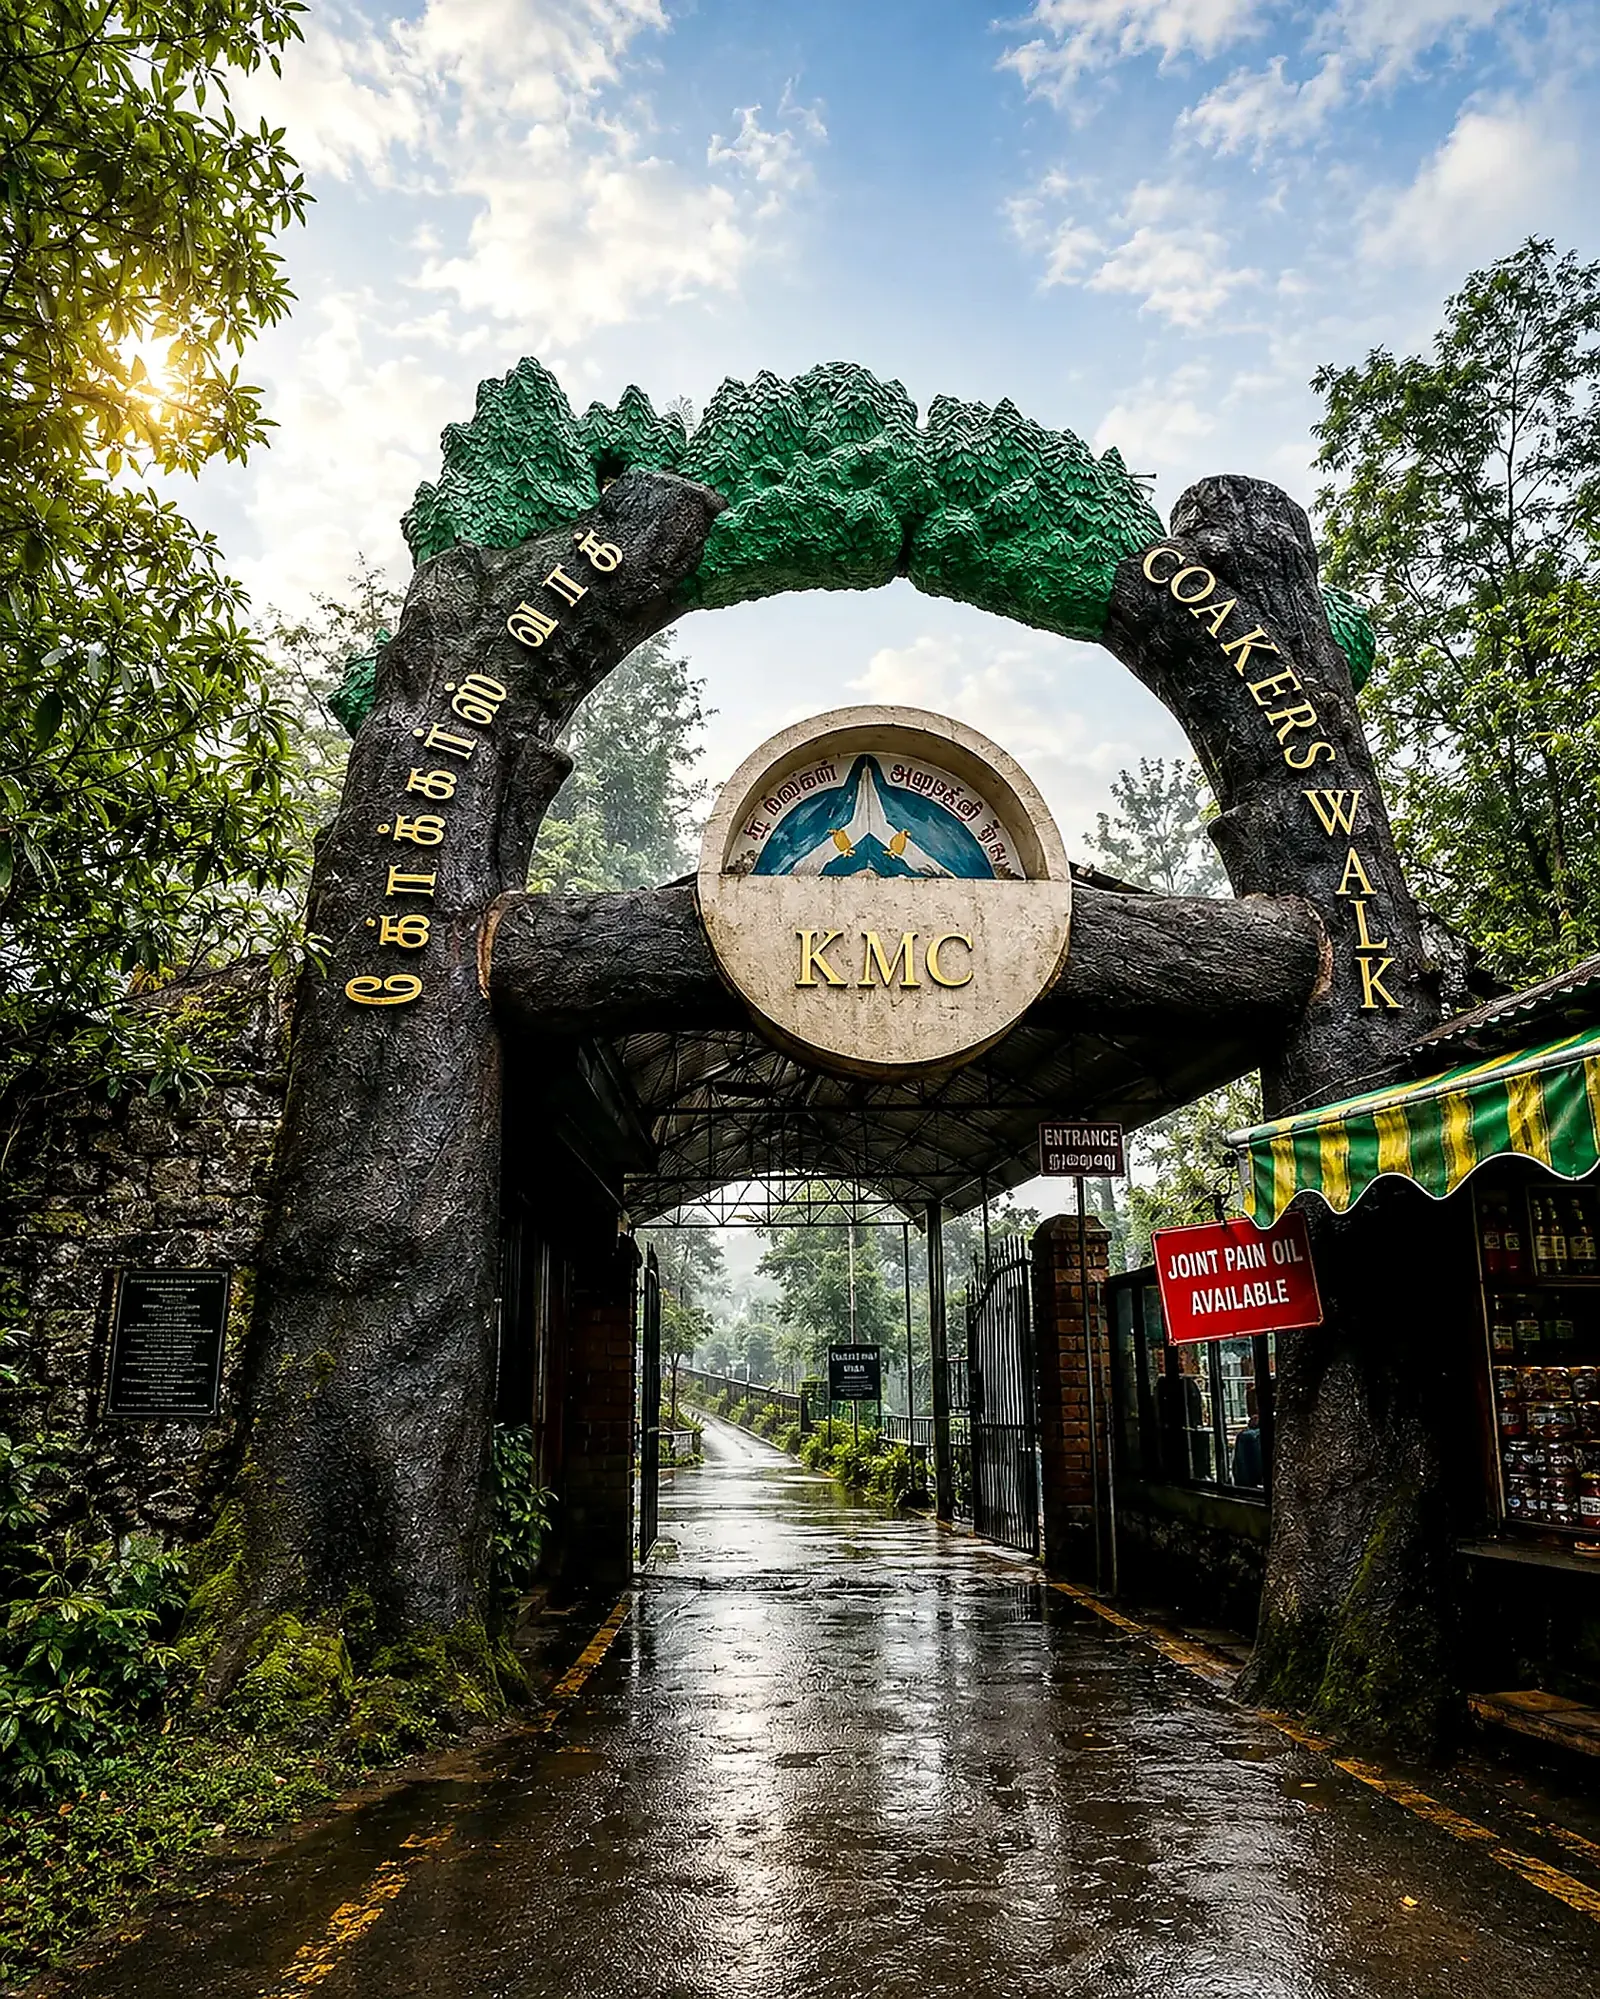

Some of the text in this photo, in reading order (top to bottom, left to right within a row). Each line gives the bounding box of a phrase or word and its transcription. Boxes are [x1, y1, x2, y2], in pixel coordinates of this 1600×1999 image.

[1142, 547, 1404, 1010] COAKERS WALK
[795, 929, 974, 988] KMC
[1044, 1129, 1119, 1147] ENTRANCE
[1167, 1238, 1304, 1280] JOINT PAIN OIL
[1191, 1279, 1290, 1316] AVAILABLE
